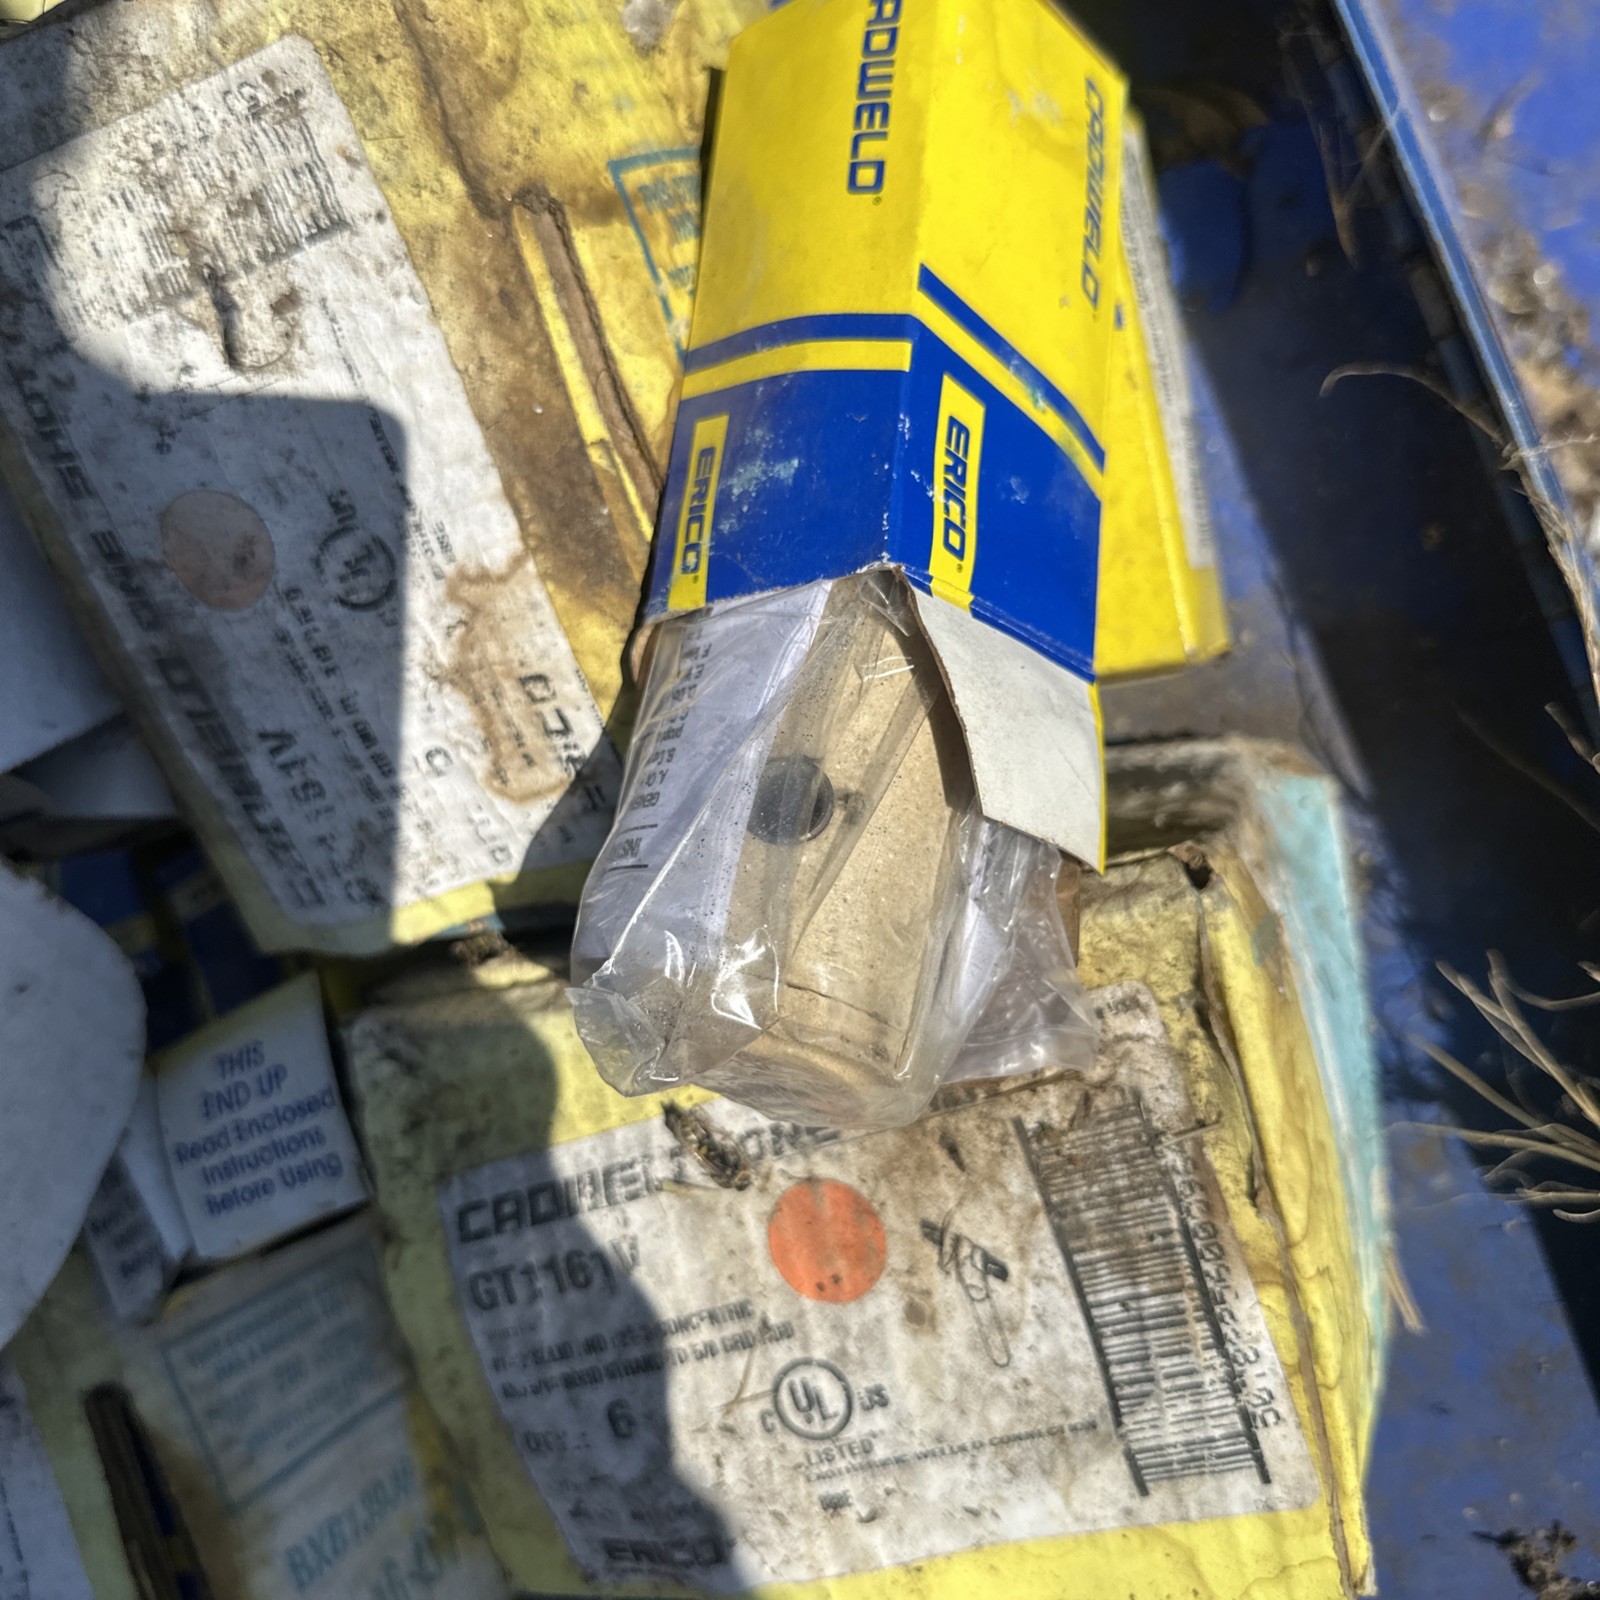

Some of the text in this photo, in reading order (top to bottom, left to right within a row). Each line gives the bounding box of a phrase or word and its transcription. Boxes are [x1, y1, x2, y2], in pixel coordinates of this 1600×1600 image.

[1081, 75, 1105, 310] CADWELD
[681, 445, 717, 576] ERICO
[941, 414, 971, 562] ERICO
[216, 1040, 265, 1080] THIS
[202, 1063, 288, 1121] END UP
[174, 1084, 335, 1166] Read Enclosed
[279, 1152, 344, 1191] Using
[456, 1153, 690, 1244] CADWEL
[607, 1399, 639, 1441] 6
[788, 1375, 839, 1425] UL
[803, 1436, 875, 1467] LISTED
